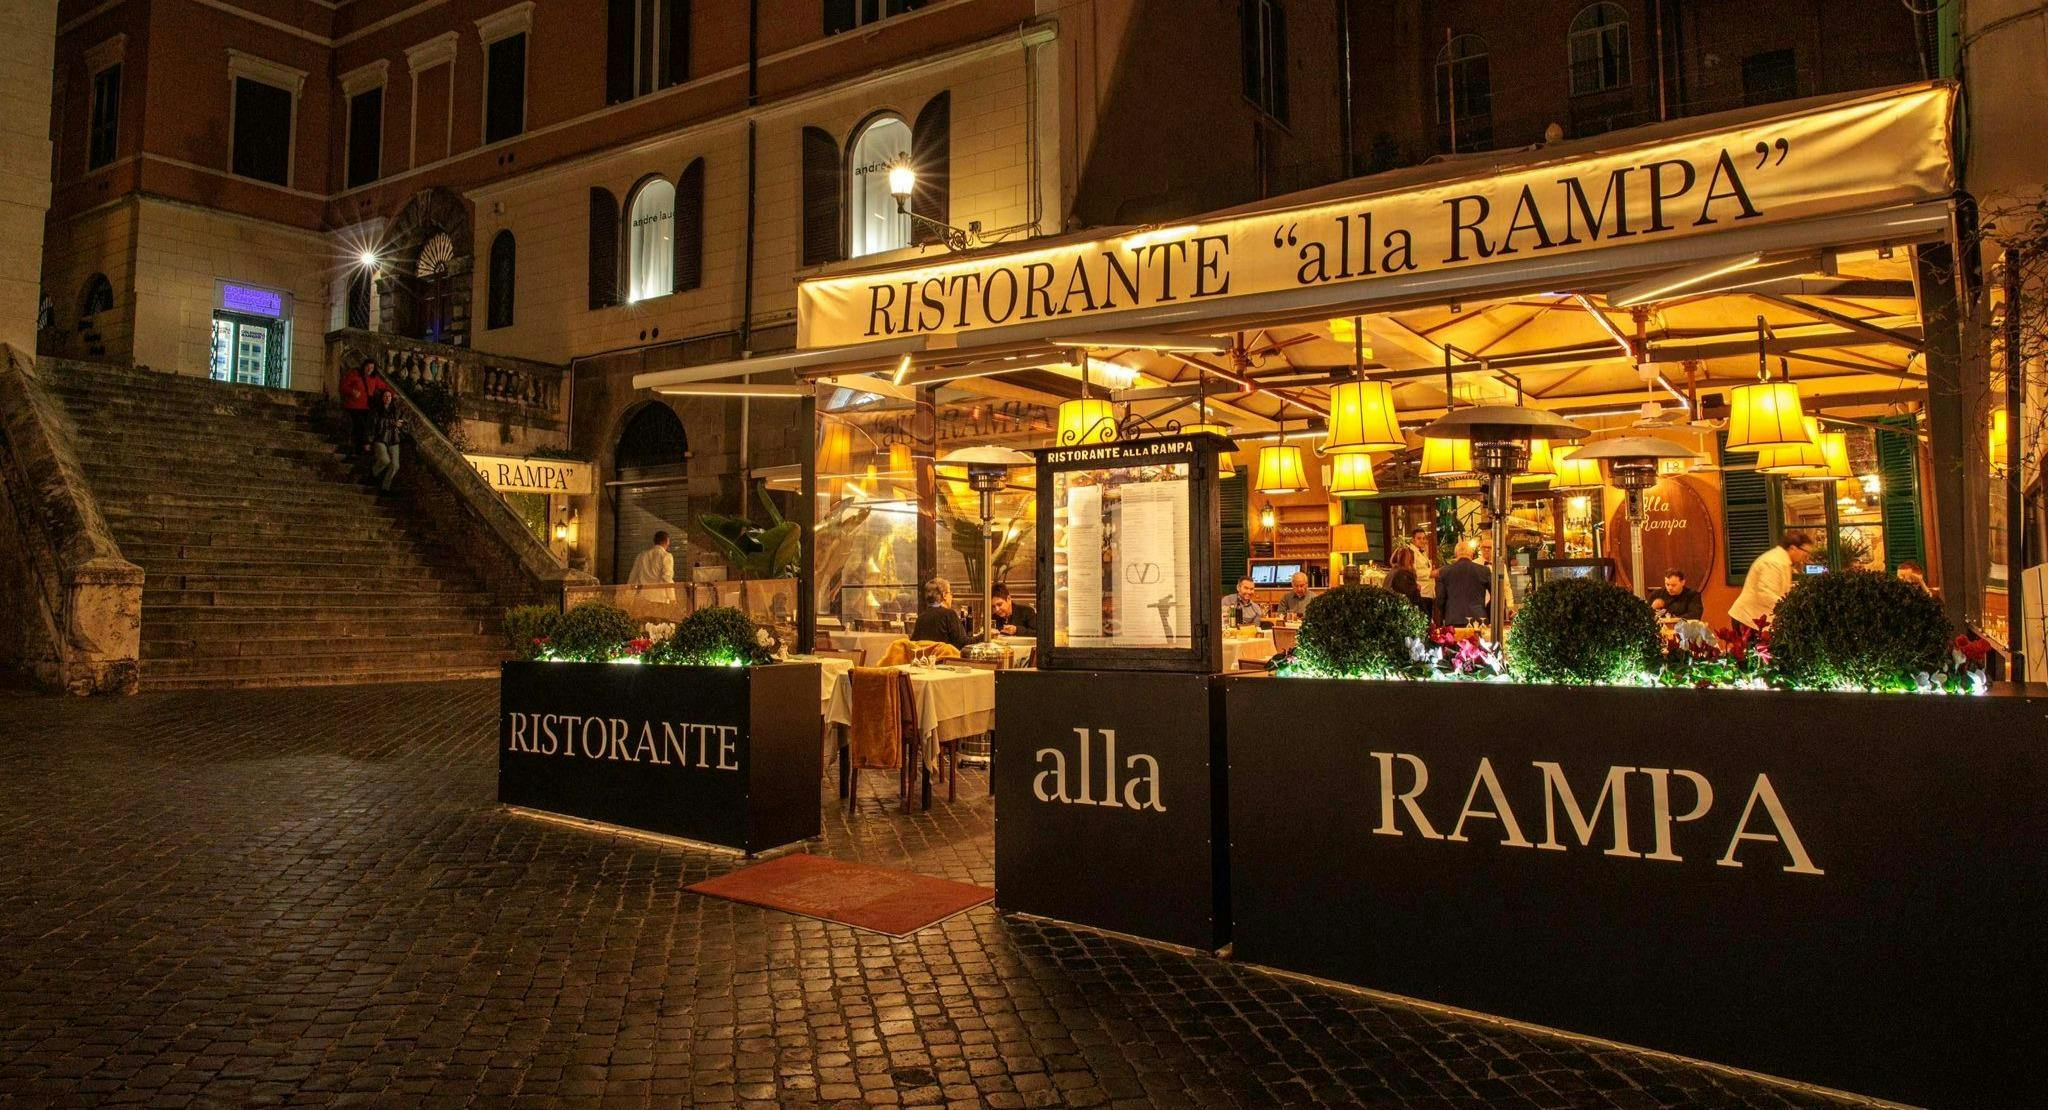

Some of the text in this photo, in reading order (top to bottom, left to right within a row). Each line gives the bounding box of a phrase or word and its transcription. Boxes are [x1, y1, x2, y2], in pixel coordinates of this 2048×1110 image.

[855, 160, 887, 176] andre
[632, 213, 658, 227] andre
[864, 138, 1790, 336] RISTORANTE “alla RAMPA”
[1047, 441, 1193, 463] RISTORANTE ALLA RAMPA
[497, 463, 574, 489] RAMPA”
[508, 712, 739, 771] RISTORANTE
[1033, 728, 1167, 812] alla
[1370, 751, 1825, 875] RAMPA
